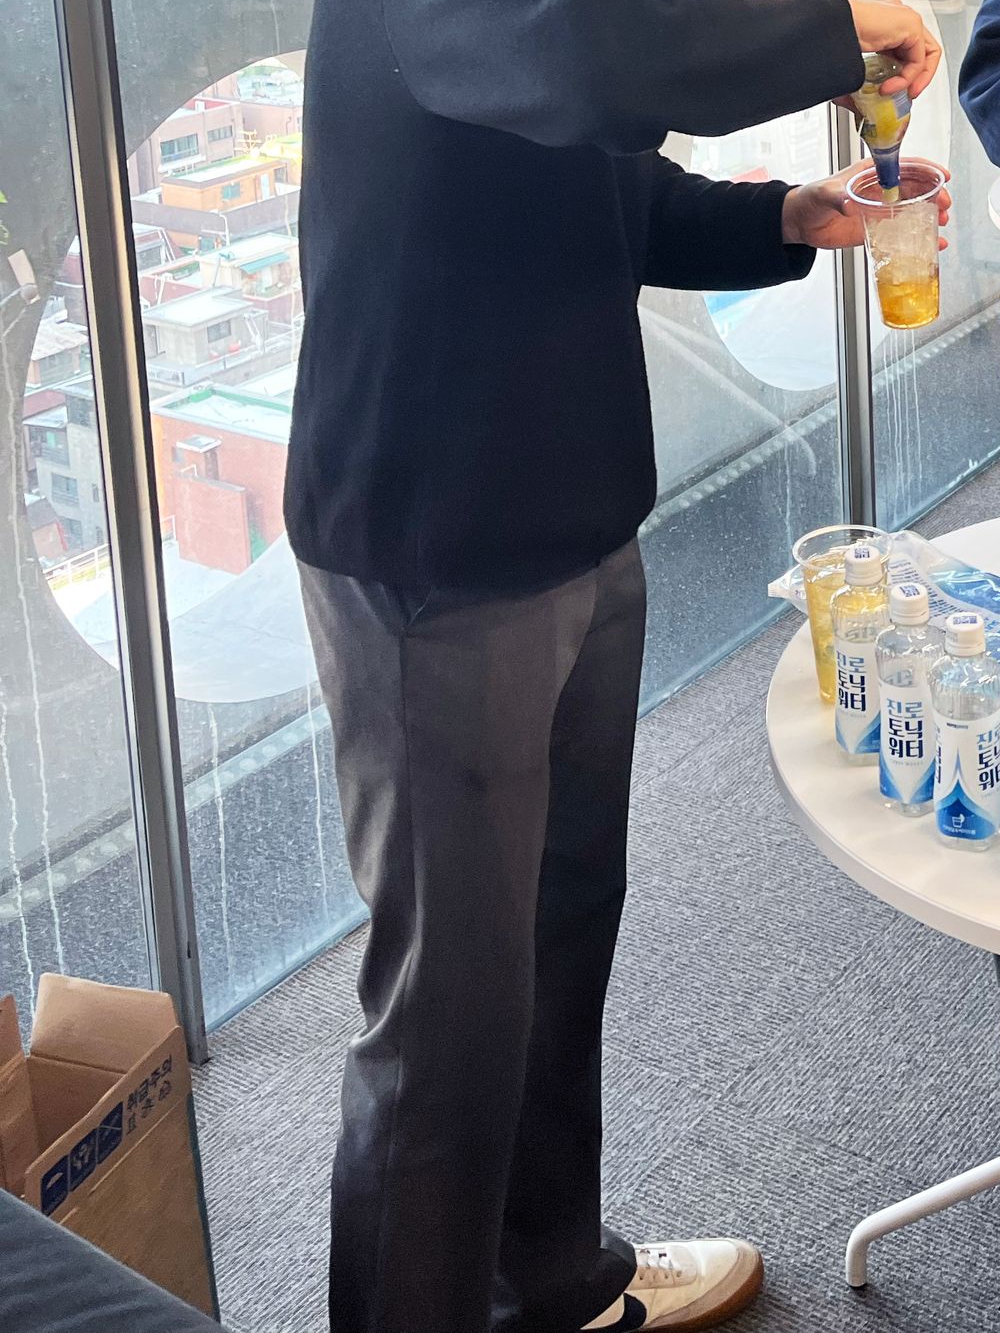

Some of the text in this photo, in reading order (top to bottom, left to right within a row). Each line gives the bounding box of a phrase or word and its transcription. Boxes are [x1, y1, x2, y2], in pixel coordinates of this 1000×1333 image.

[838, 669, 866, 693] 토닉
[838, 688, 866, 712] 워터
[887, 698, 924, 719] 진로
[888, 718, 924, 739] 토닉
[888, 737, 924, 758] 워터
